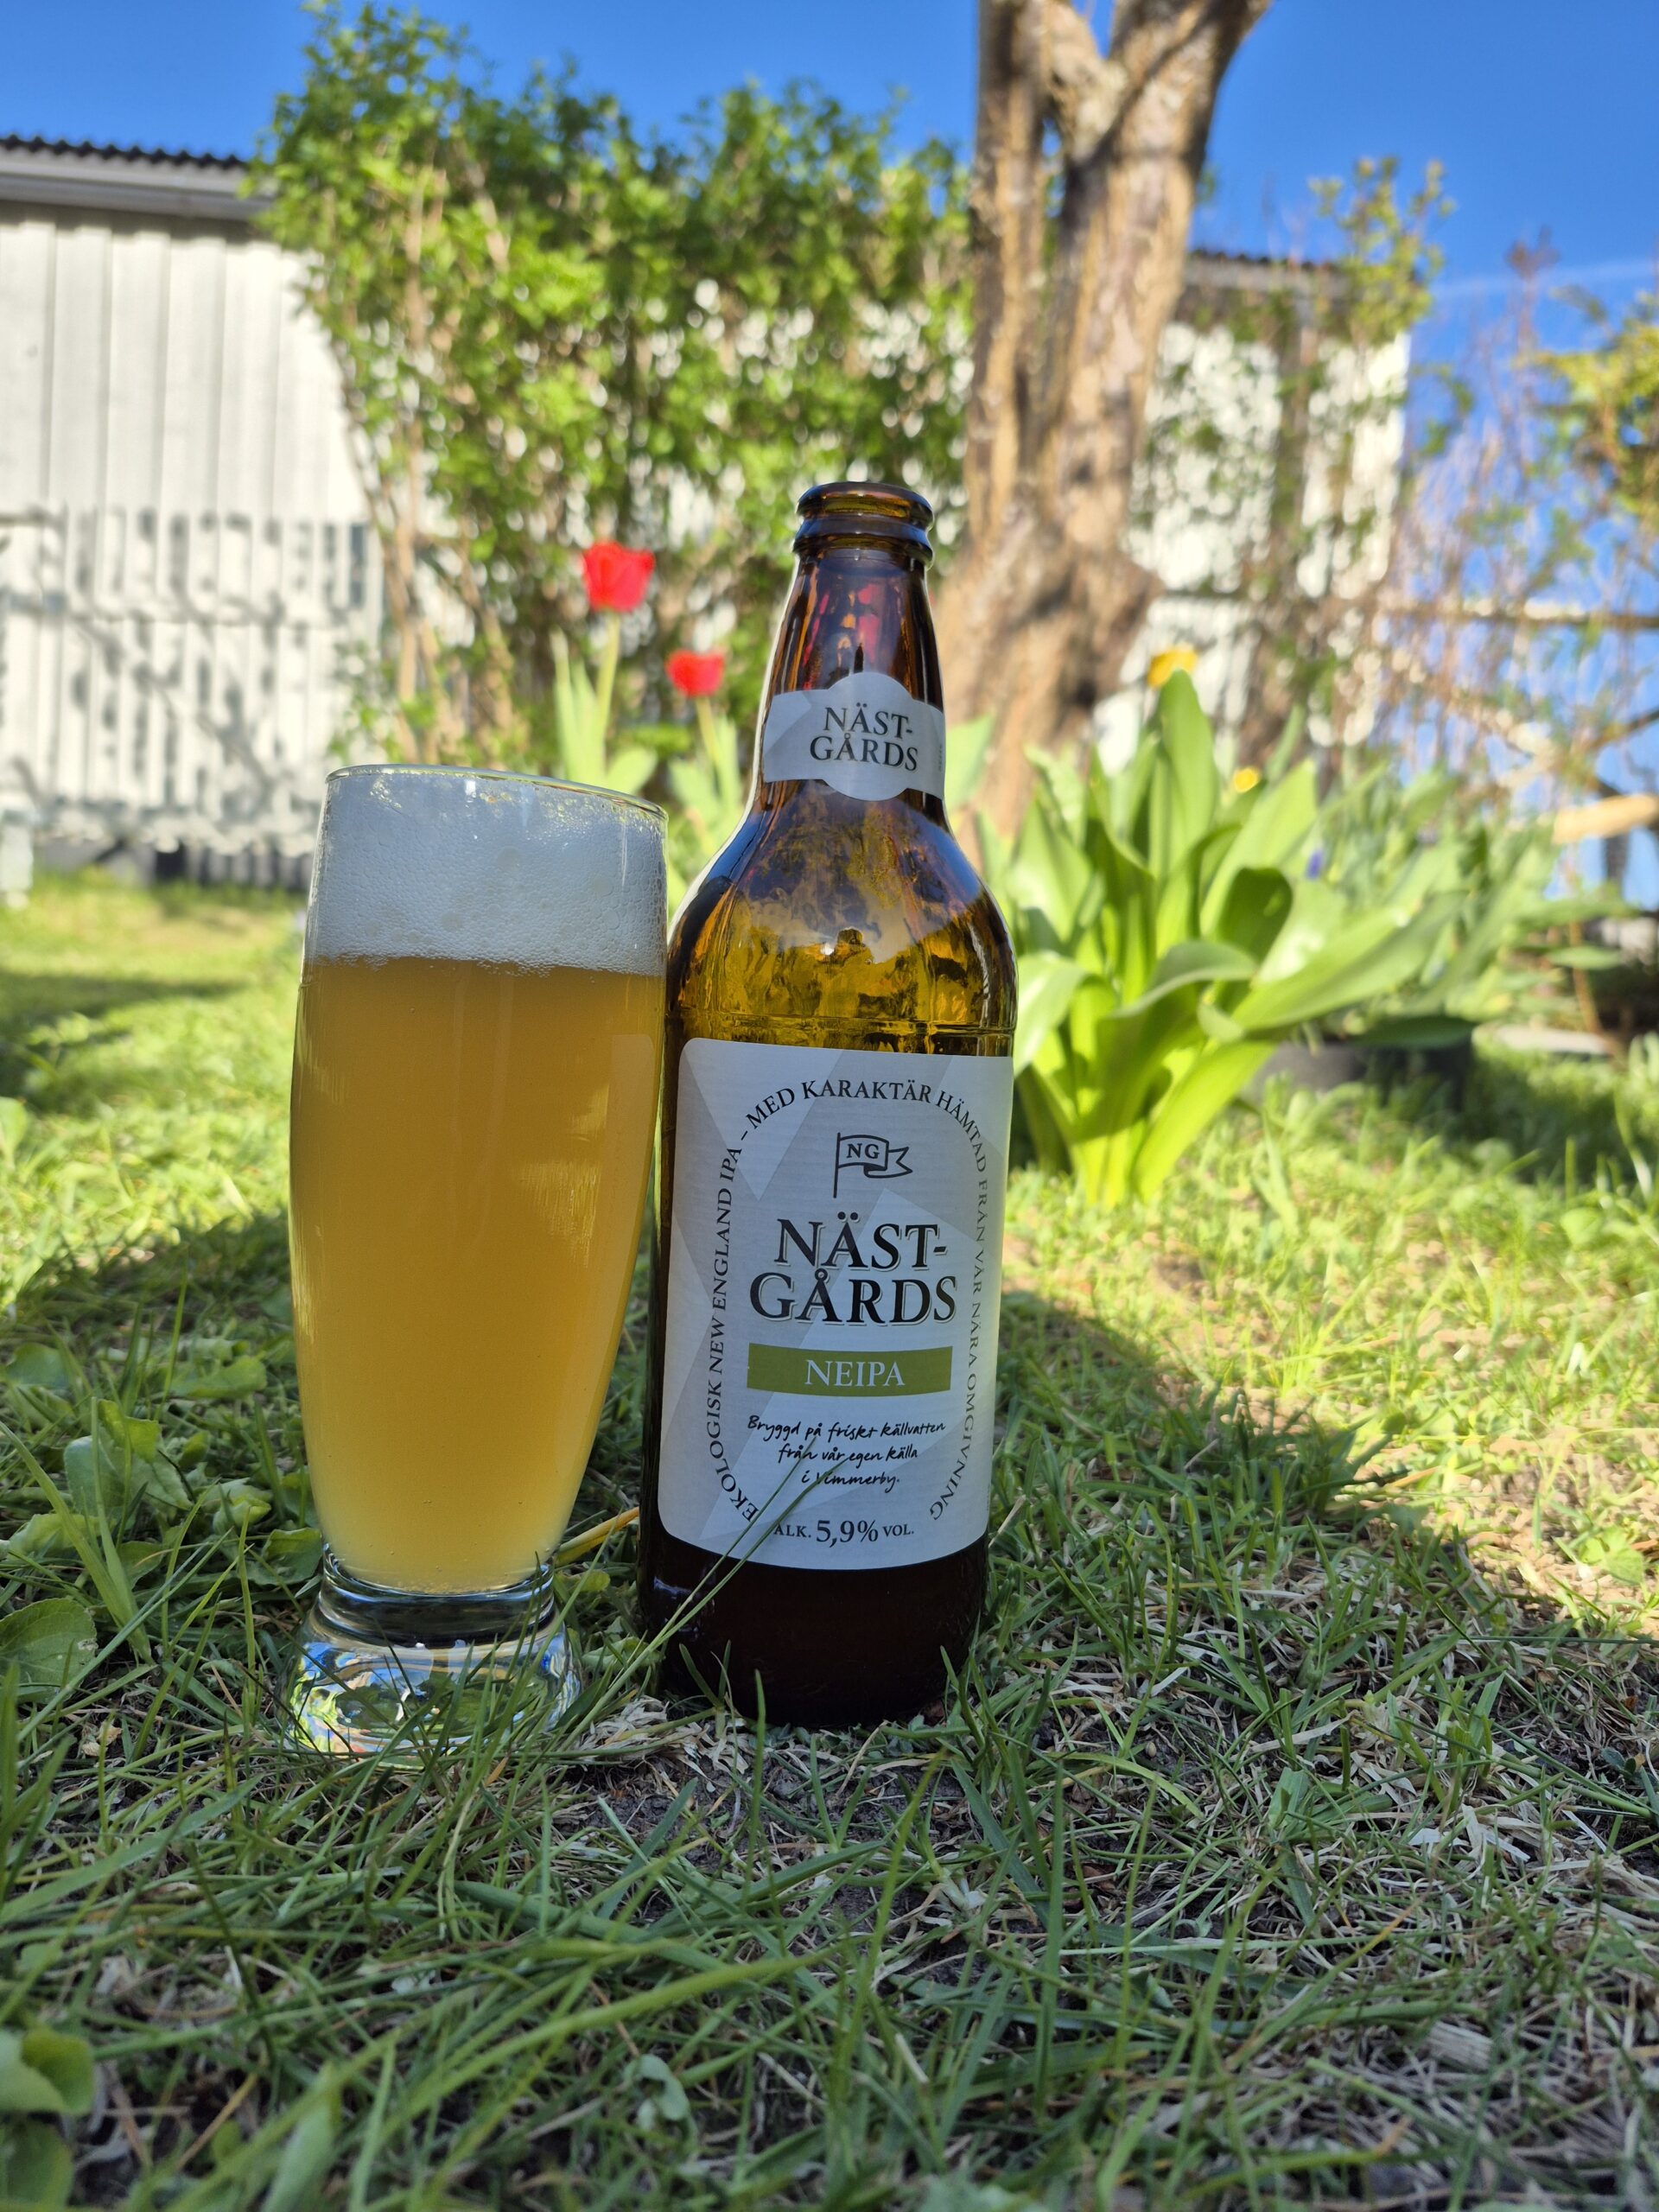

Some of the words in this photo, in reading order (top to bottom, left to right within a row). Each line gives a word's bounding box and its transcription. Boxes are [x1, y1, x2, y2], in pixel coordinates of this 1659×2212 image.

[823, 702, 913, 739] NÄST-
[810, 733, 918, 772] GÅRDS
[746, 1088, 796, 1129] MED
[802, 1079, 932, 1103] KARAKTÄR
[846, 1143, 880, 1160] NG
[935, 1090, 988, 1173] HÄMTAD
[720, 1148, 742, 1182] IPA
[976, 1179, 988, 1243] FRÅN
[712, 1188, 732, 1311] ENGLAND
[774, 1211, 948, 1271] NÄST-
[750, 1268, 957, 1326] GÅRDS
[709, 1313, 726, 1375] NEW
[969, 1302, 982, 1368] NÄRA
[804, 1359, 906, 1387] NEIPA
[747, 1414, 802, 1442] Bryggd
[804, 1422, 823, 1440] på
[828, 1422, 878, 1443] friskt
[880, 1421, 946, 1438] källvatten
[930, 1373, 977, 1521] OMGIVNING
[707, 1380, 760, 1522] EKOLOGISK
[779, 1443, 818, 1464] från
[822, 1446, 846, 1460] vår
[849, 1452, 883, 1469] egen
[885, 1444, 918, 1461] källa
[801, 1470, 810, 1484] i
[773, 1521, 812, 1538] ALK.
[816, 1519, 880, 1548] 5,9%
[882, 1523, 915, 1537] VOL.
